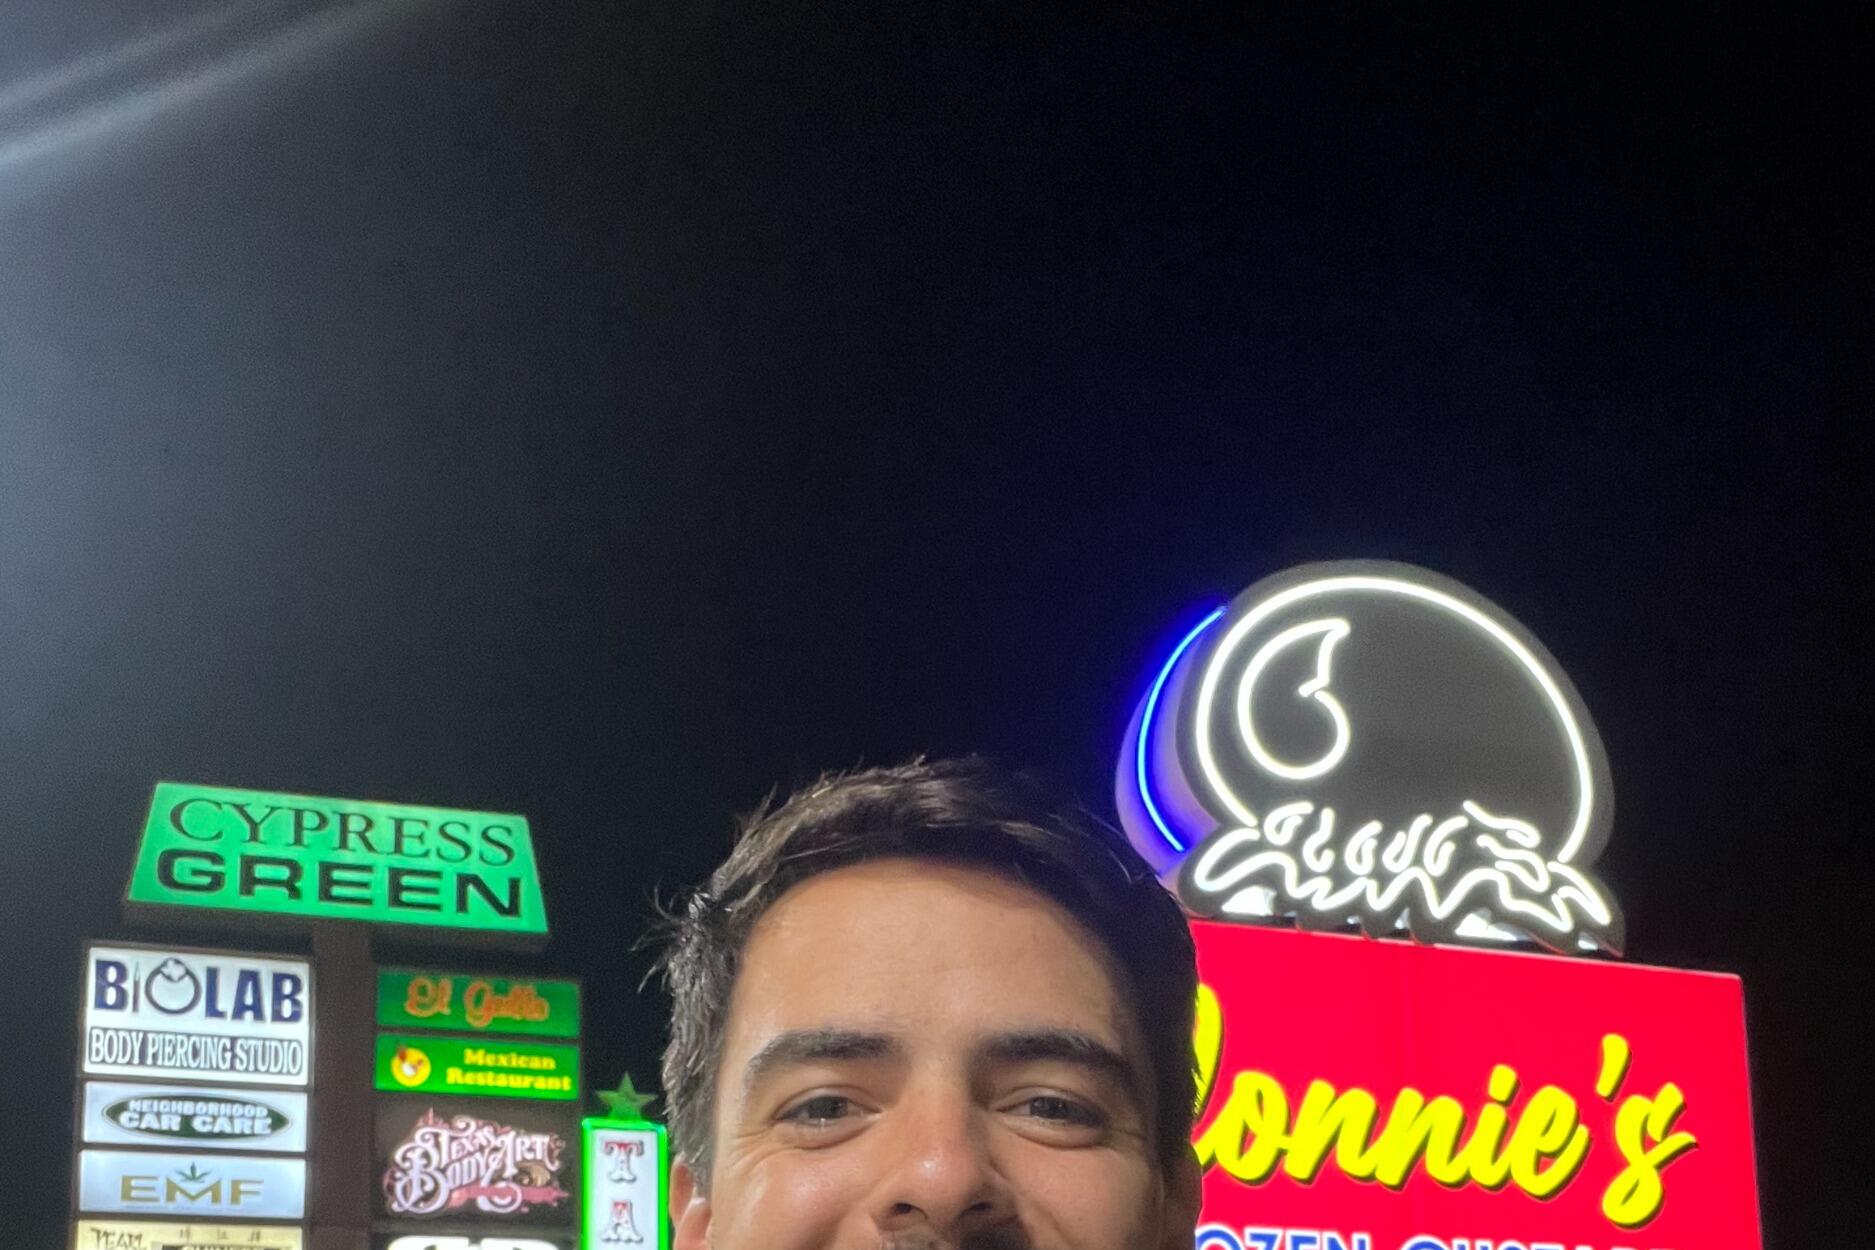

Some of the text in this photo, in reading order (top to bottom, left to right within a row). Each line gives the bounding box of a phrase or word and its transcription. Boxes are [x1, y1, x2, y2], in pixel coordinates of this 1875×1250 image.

[169, 798, 516, 867] CYPRESS
[156, 848, 521, 919] GREEN
[90, 1028, 303, 1073] BODY PIERCING STUDIO
[464, 1048, 556, 1070] Mexican
[445, 1067, 573, 1092] Restaurant
[127, 1099, 269, 1118] NEIGHBORHOOD
[118, 1112, 273, 1135] CAR CARE
[120, 1174, 265, 1206] EMF
